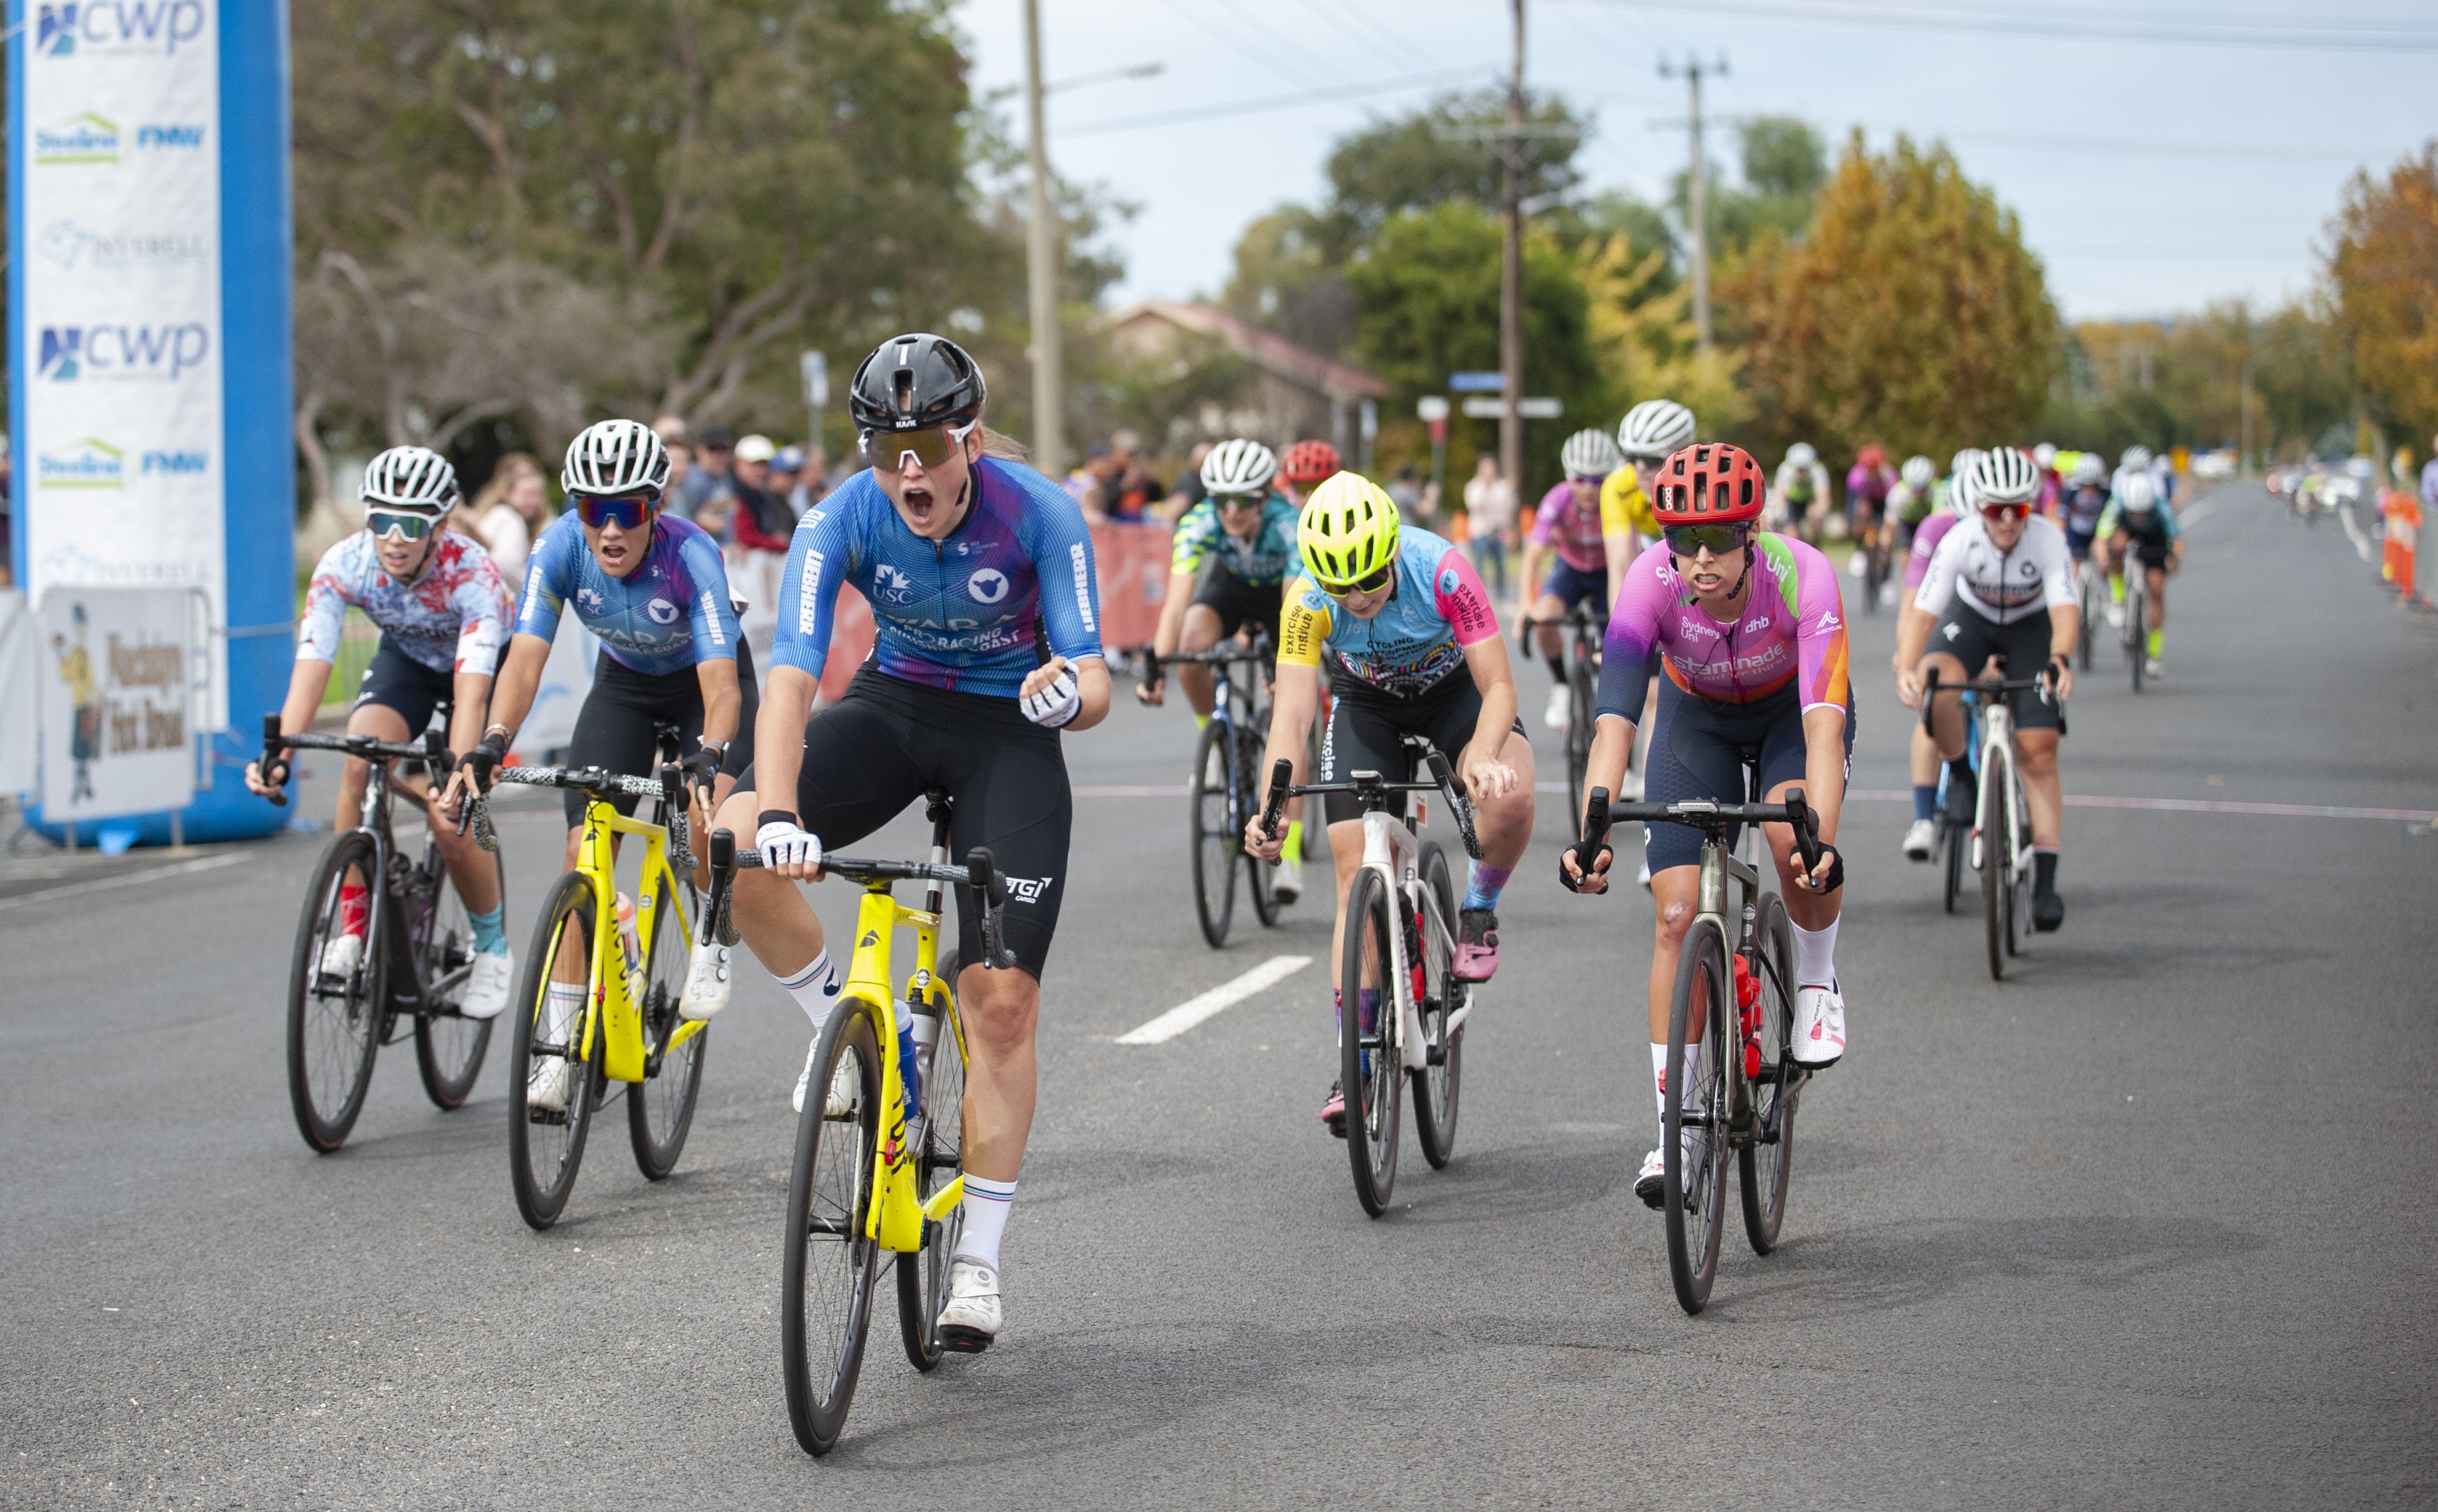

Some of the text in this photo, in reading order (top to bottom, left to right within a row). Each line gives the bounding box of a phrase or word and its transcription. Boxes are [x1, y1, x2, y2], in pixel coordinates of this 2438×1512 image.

[1766, 552, 1792, 583] Uni
[799, 548, 825, 636] LIEBHERR
[872, 585, 914, 604] USC
[1069, 541, 1096, 632] LIEBHERR
[1681, 616, 1720, 640] Sydney
[1745, 615, 1770, 634] dhb
[1366, 636, 1415, 648] CYCLING
[1680, 628, 1699, 643] Uni
[1673, 643, 1785, 676] staminade
[1015, 895, 1036, 904] CARGO
